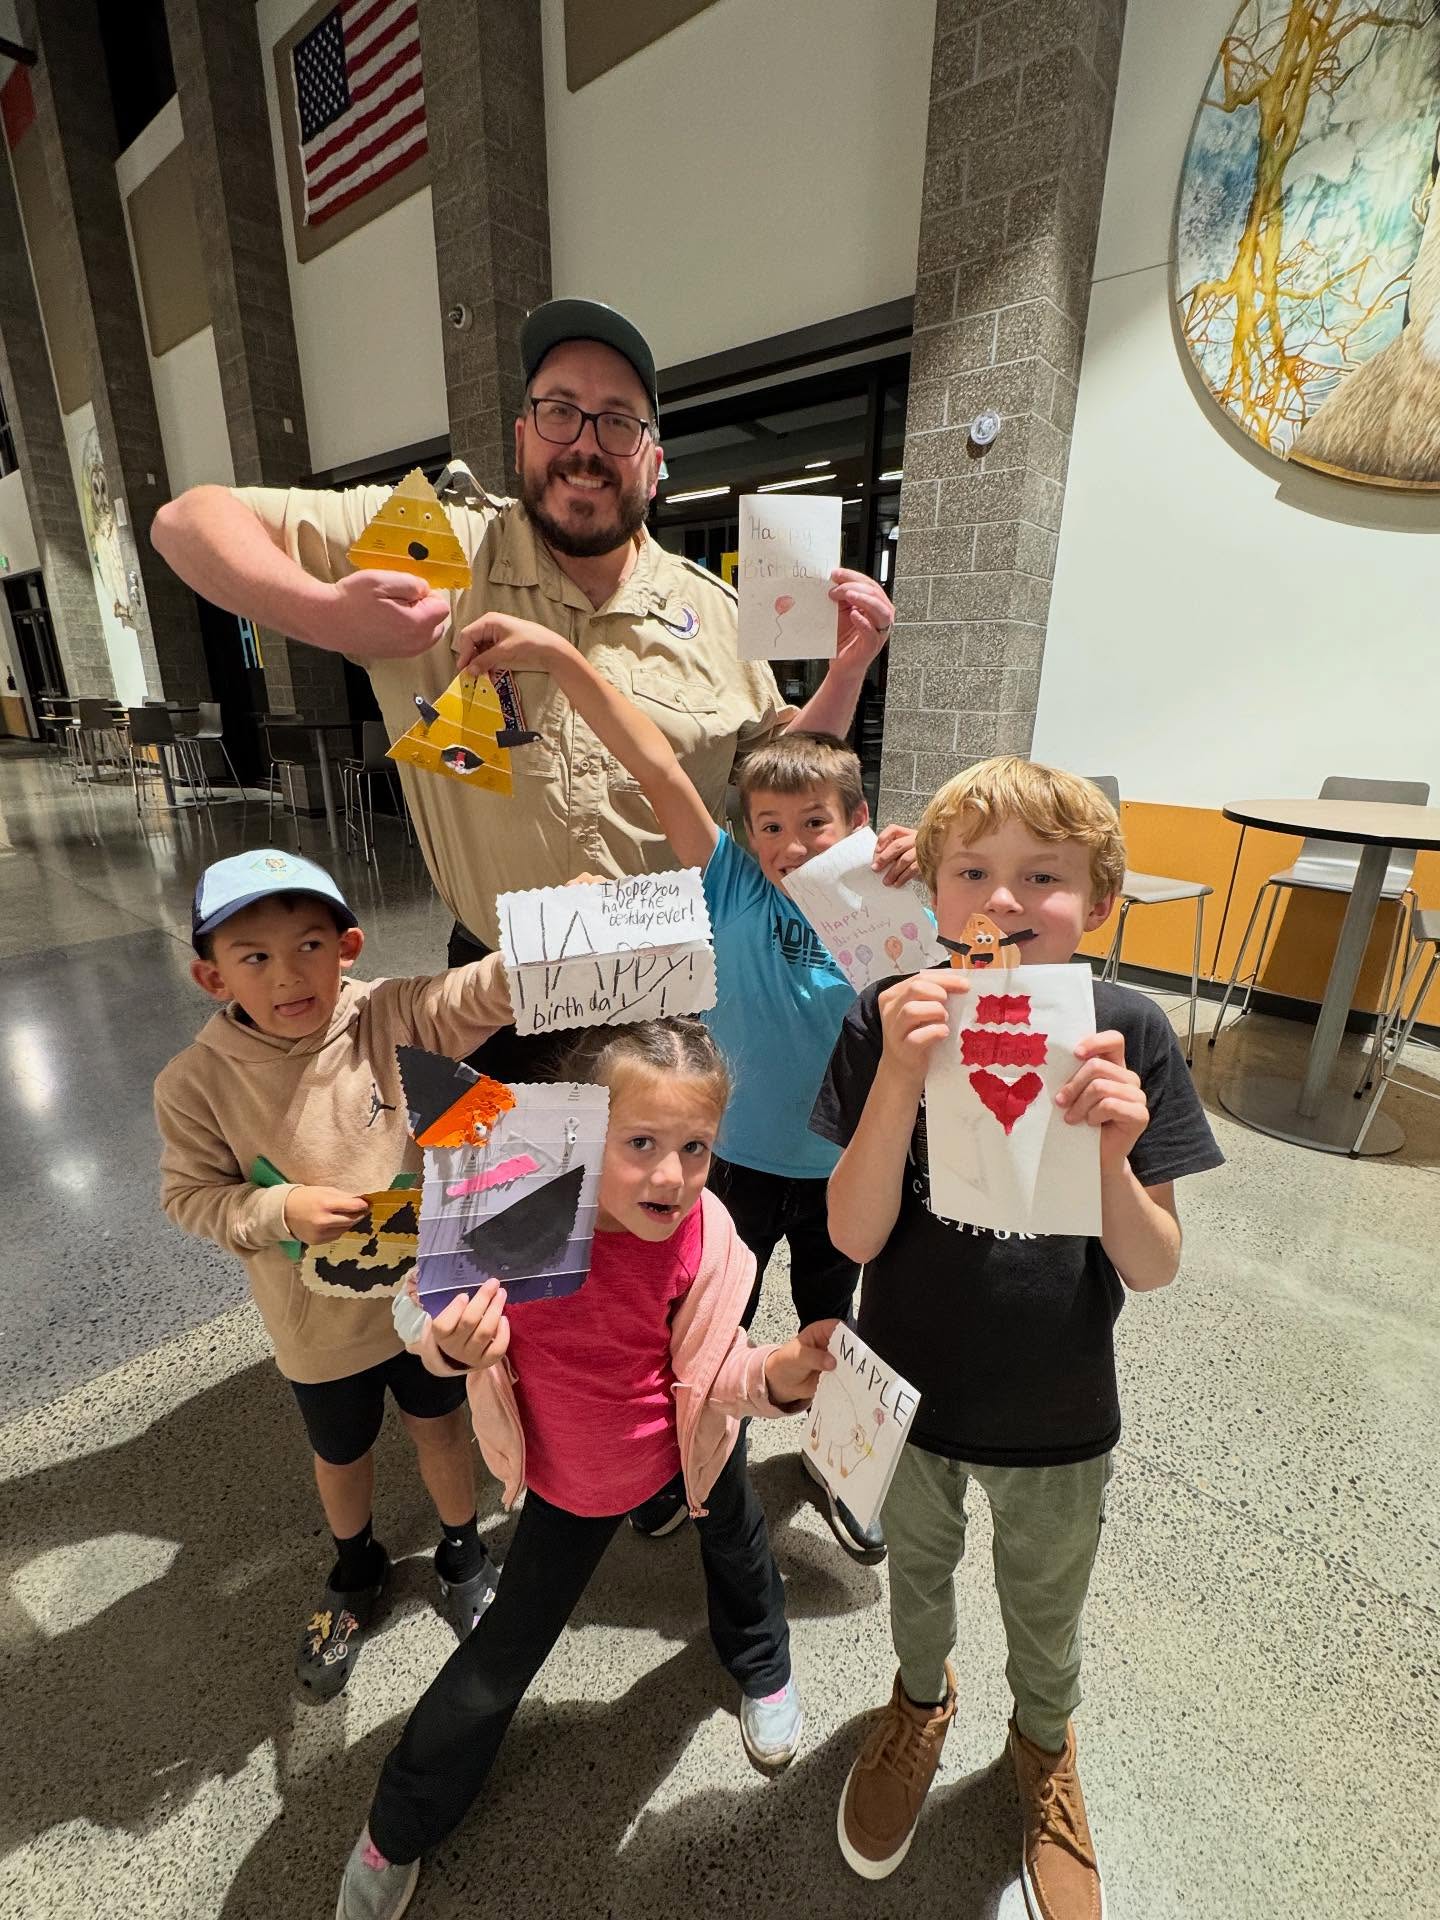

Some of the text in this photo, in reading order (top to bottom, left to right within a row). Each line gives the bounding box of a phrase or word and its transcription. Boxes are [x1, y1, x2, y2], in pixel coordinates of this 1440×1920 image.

[748, 515, 814, 552] Hapy
[600, 880, 680, 902] I hope you
[602, 896, 664, 914] have the
[839, 1333, 916, 1428] MAPLE
